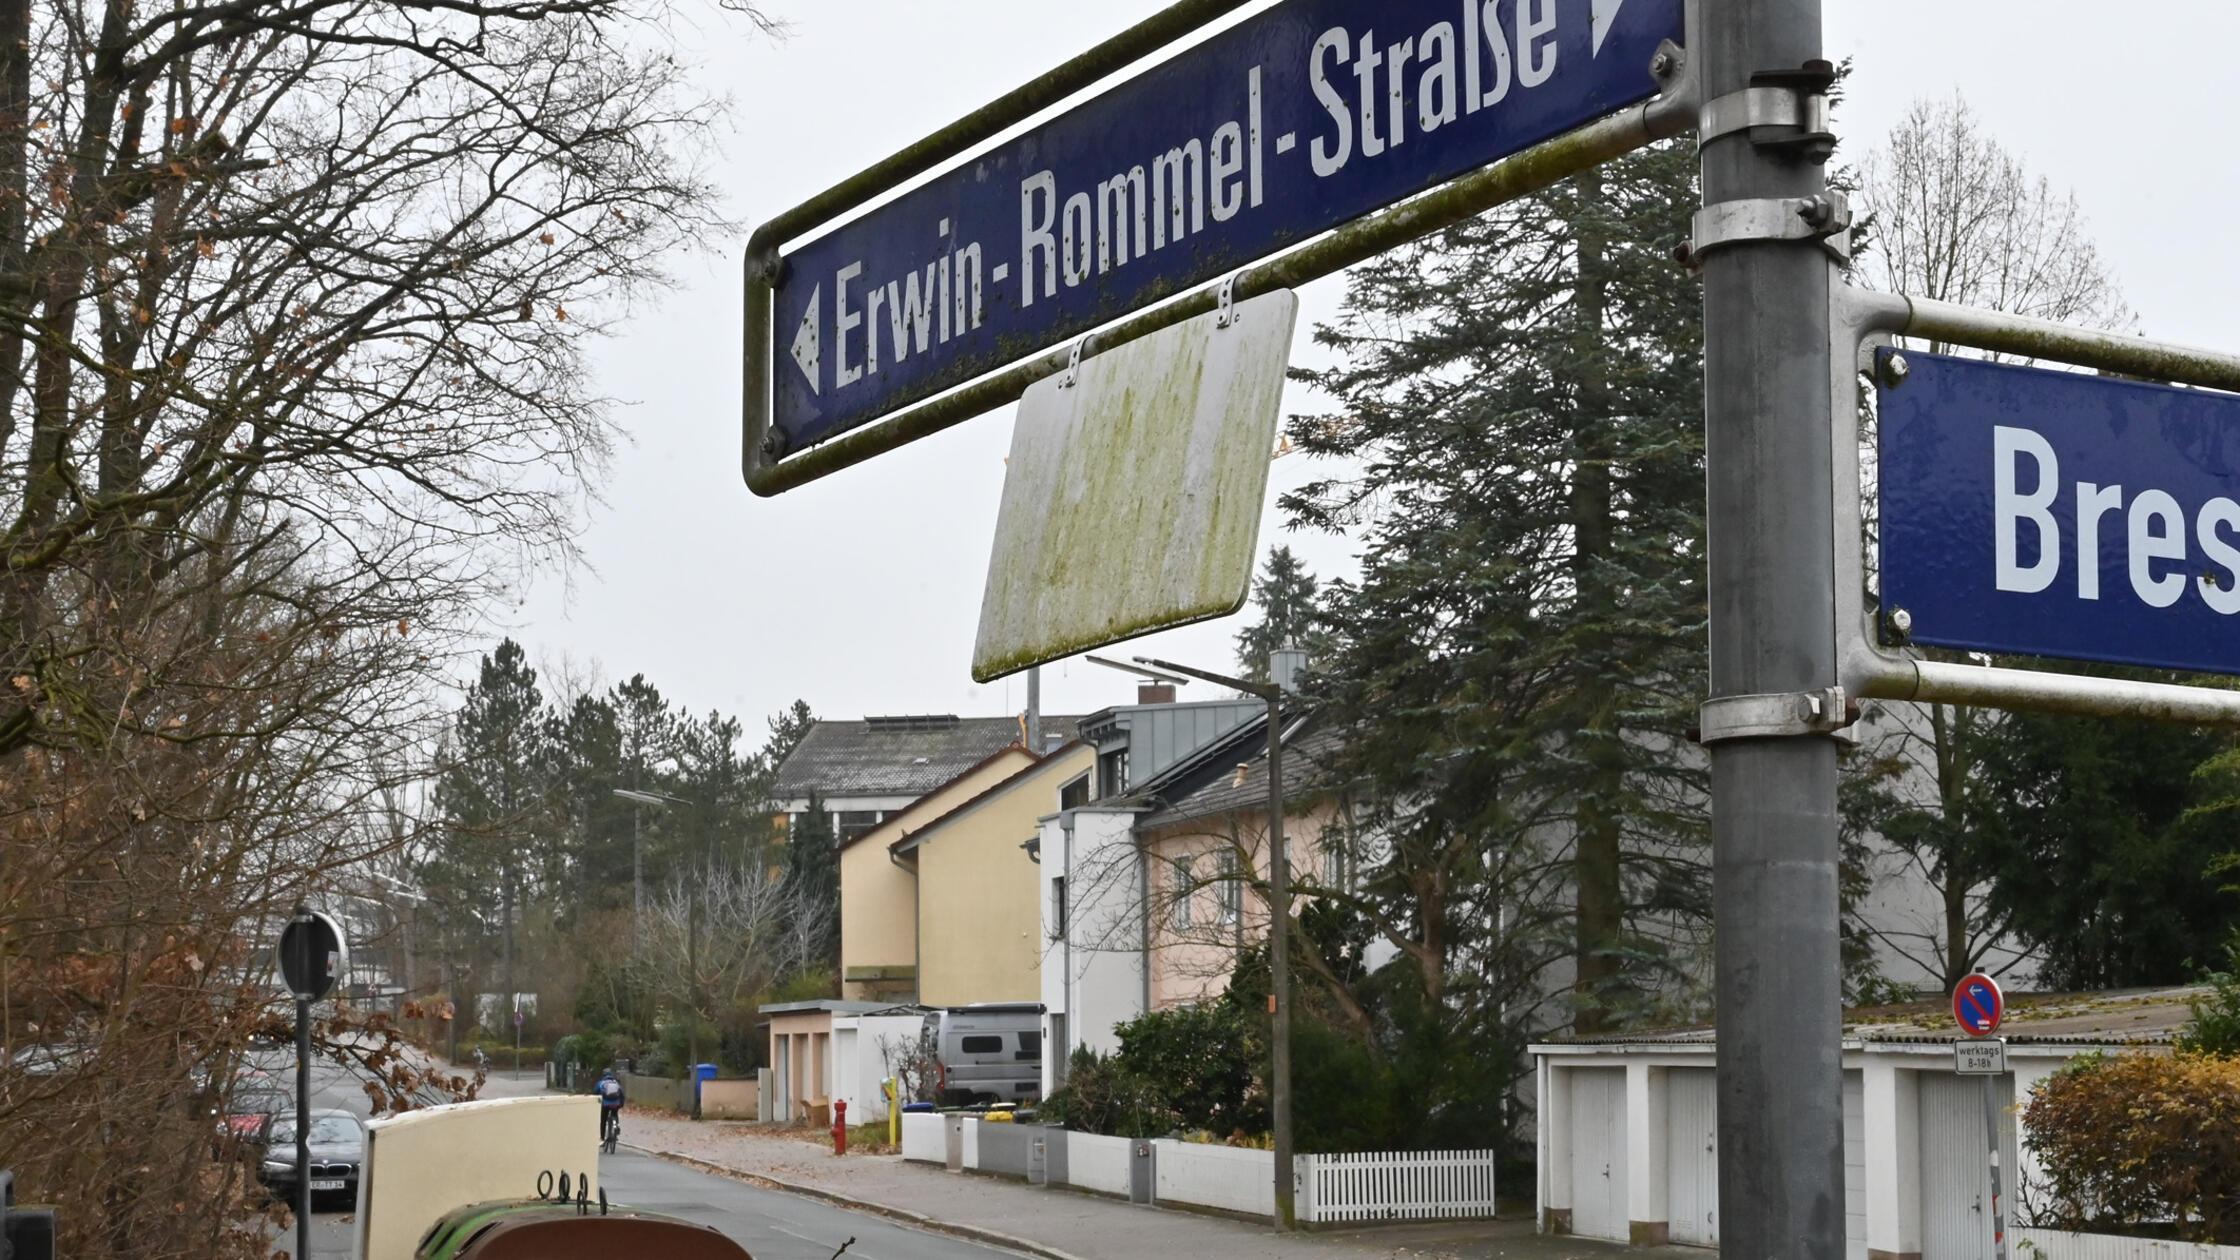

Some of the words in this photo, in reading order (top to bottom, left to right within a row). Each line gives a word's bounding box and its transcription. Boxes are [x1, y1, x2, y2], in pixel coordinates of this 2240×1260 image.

[835, 0, 1558, 390] Erwin-Rommel-Straße
[1993, 424, 2240, 615] Bres
[1959, 1046, 2000, 1057] werktags
